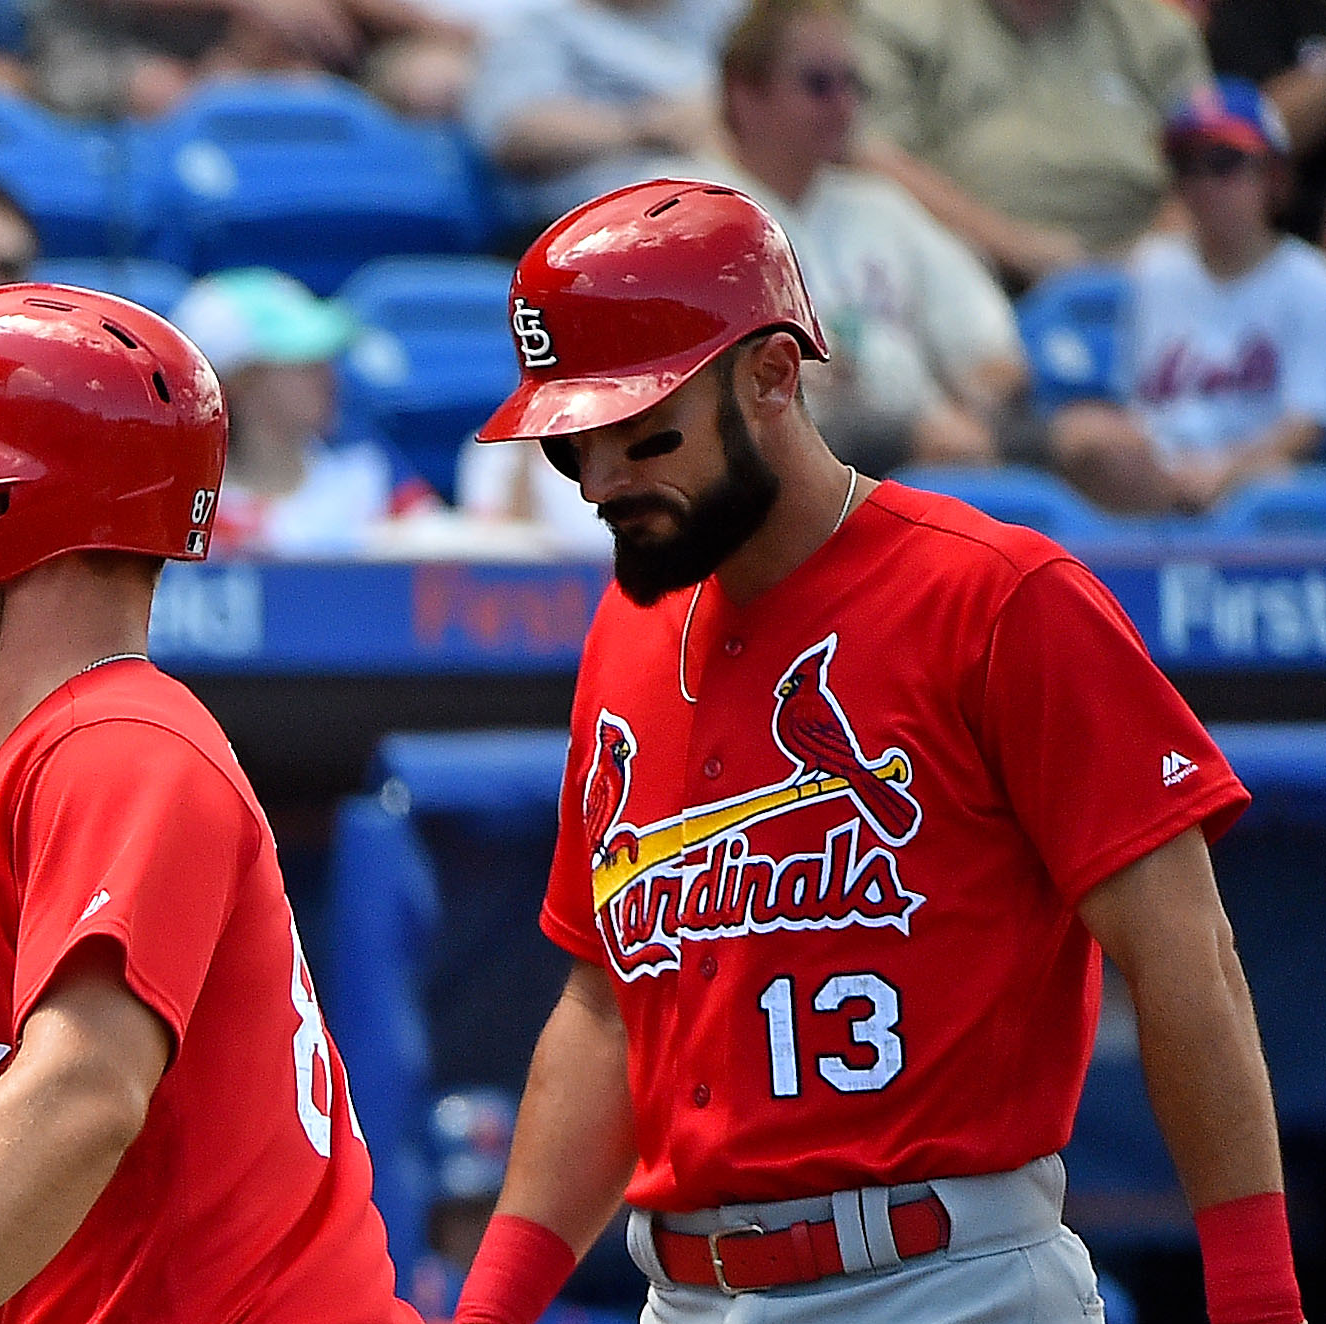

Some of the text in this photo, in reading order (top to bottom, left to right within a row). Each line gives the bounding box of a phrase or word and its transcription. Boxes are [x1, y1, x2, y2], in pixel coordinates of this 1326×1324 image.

[191, 489, 216, 525] 87
[595, 817, 928, 983] Cardinals
[284, 894, 368, 1159] 8
[758, 972, 904, 1098] 13
